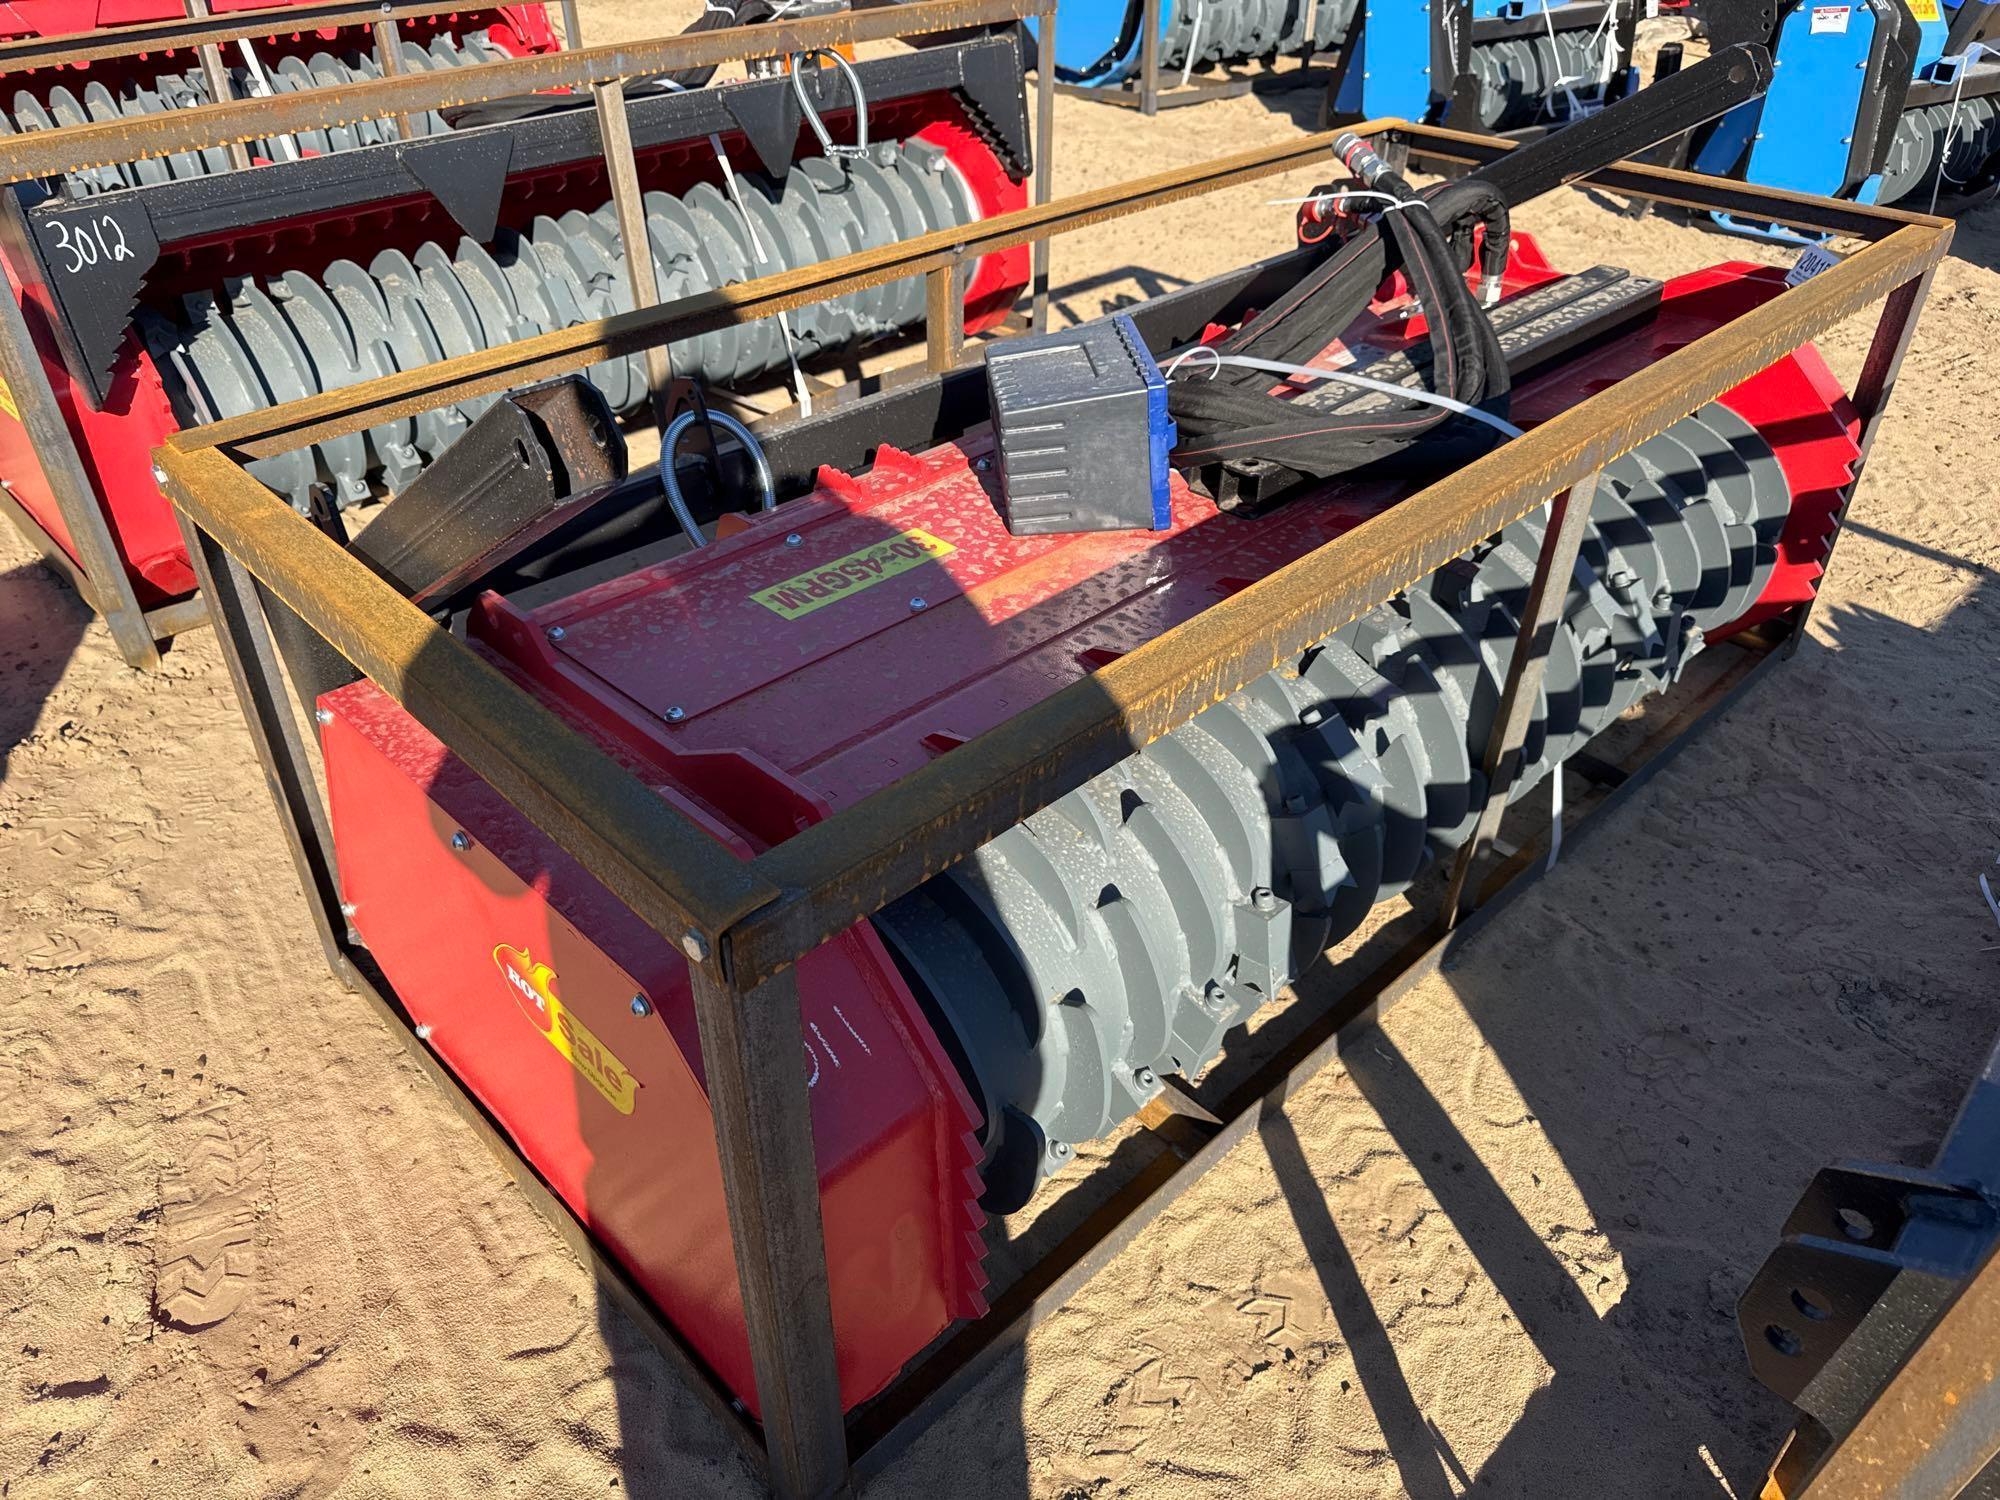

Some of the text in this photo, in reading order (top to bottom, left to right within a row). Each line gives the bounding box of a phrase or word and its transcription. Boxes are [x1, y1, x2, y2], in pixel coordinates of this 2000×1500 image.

[45, 215, 135, 273] 3012
[506, 963, 546, 1013] HOT
[557, 1012, 623, 1093] Sale
